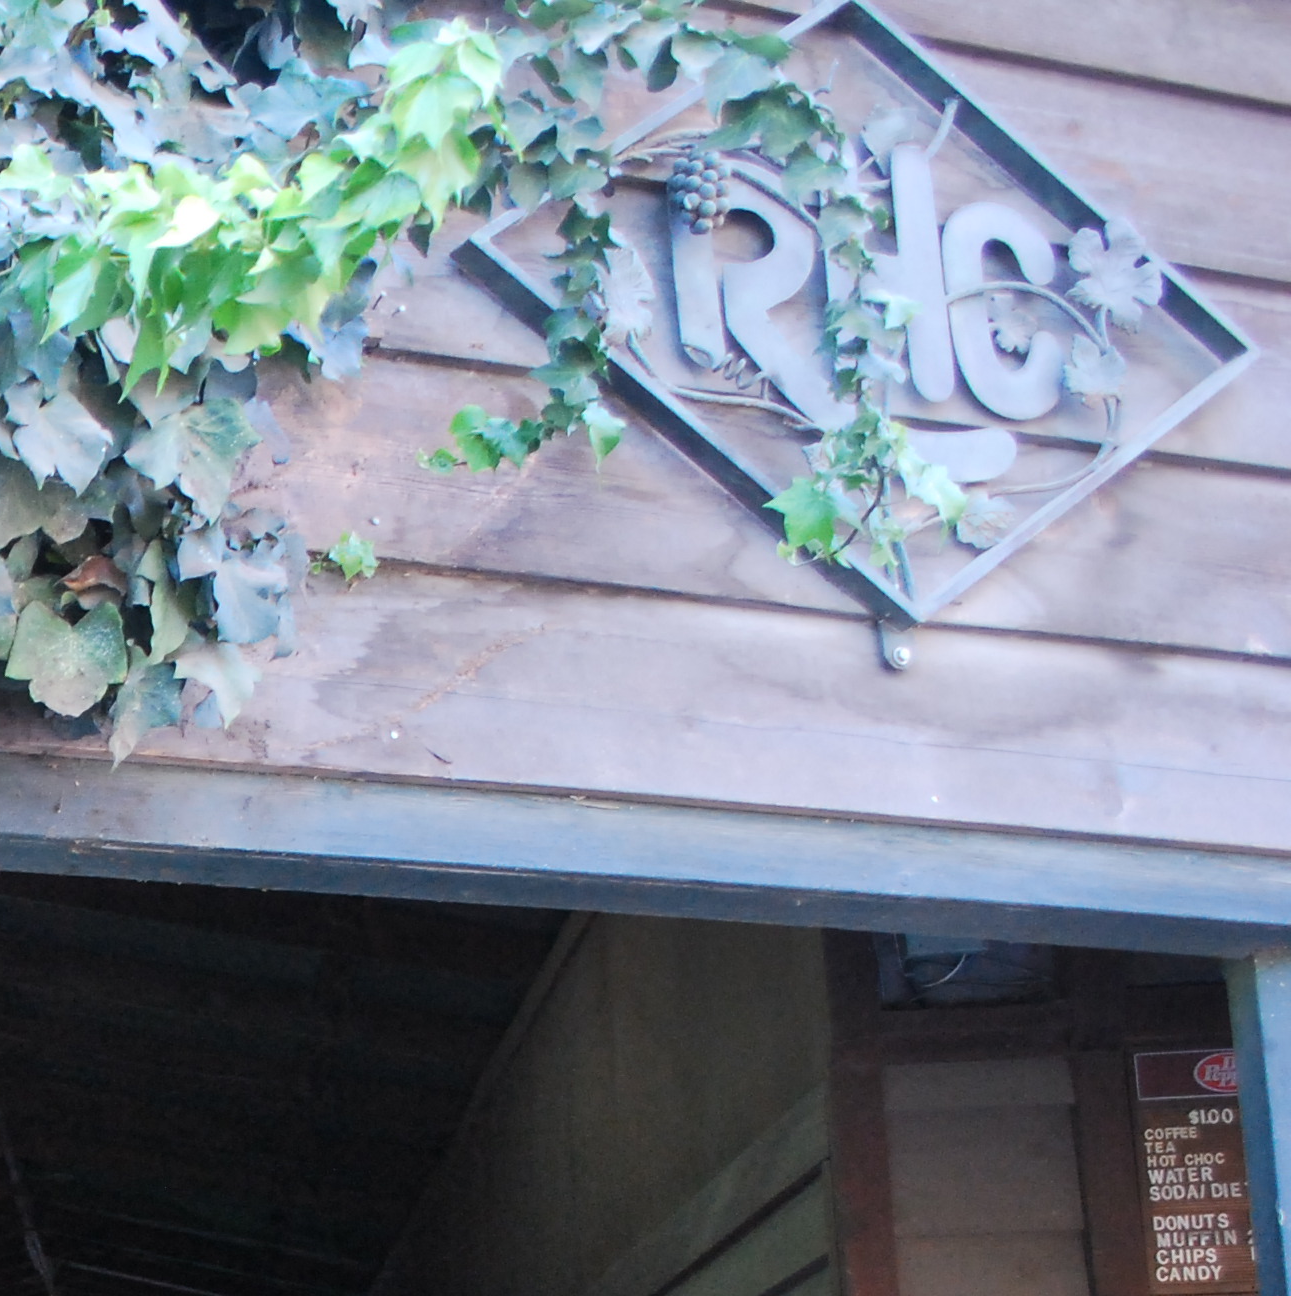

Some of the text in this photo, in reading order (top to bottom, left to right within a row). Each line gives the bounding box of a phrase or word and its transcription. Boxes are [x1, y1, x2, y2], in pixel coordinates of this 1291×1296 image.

[1188, 1108, 1234, 1124] $1.00
[1144, 1127, 1197, 1140] COFFEE
[1144, 1141, 1176, 1154] TEA
[1147, 1153, 1225, 1167] HOT CHOC
[1148, 1167, 1213, 1184] WATER
[1211, 1183, 1249, 1198] DIE
[1153, 1213, 1229, 1231] DONUTS
[1156, 1229, 1237, 1248] MUFFIN
[1155, 1247, 1217, 1265] CHIPS
[1155, 1265, 1222, 1282] CANDY
